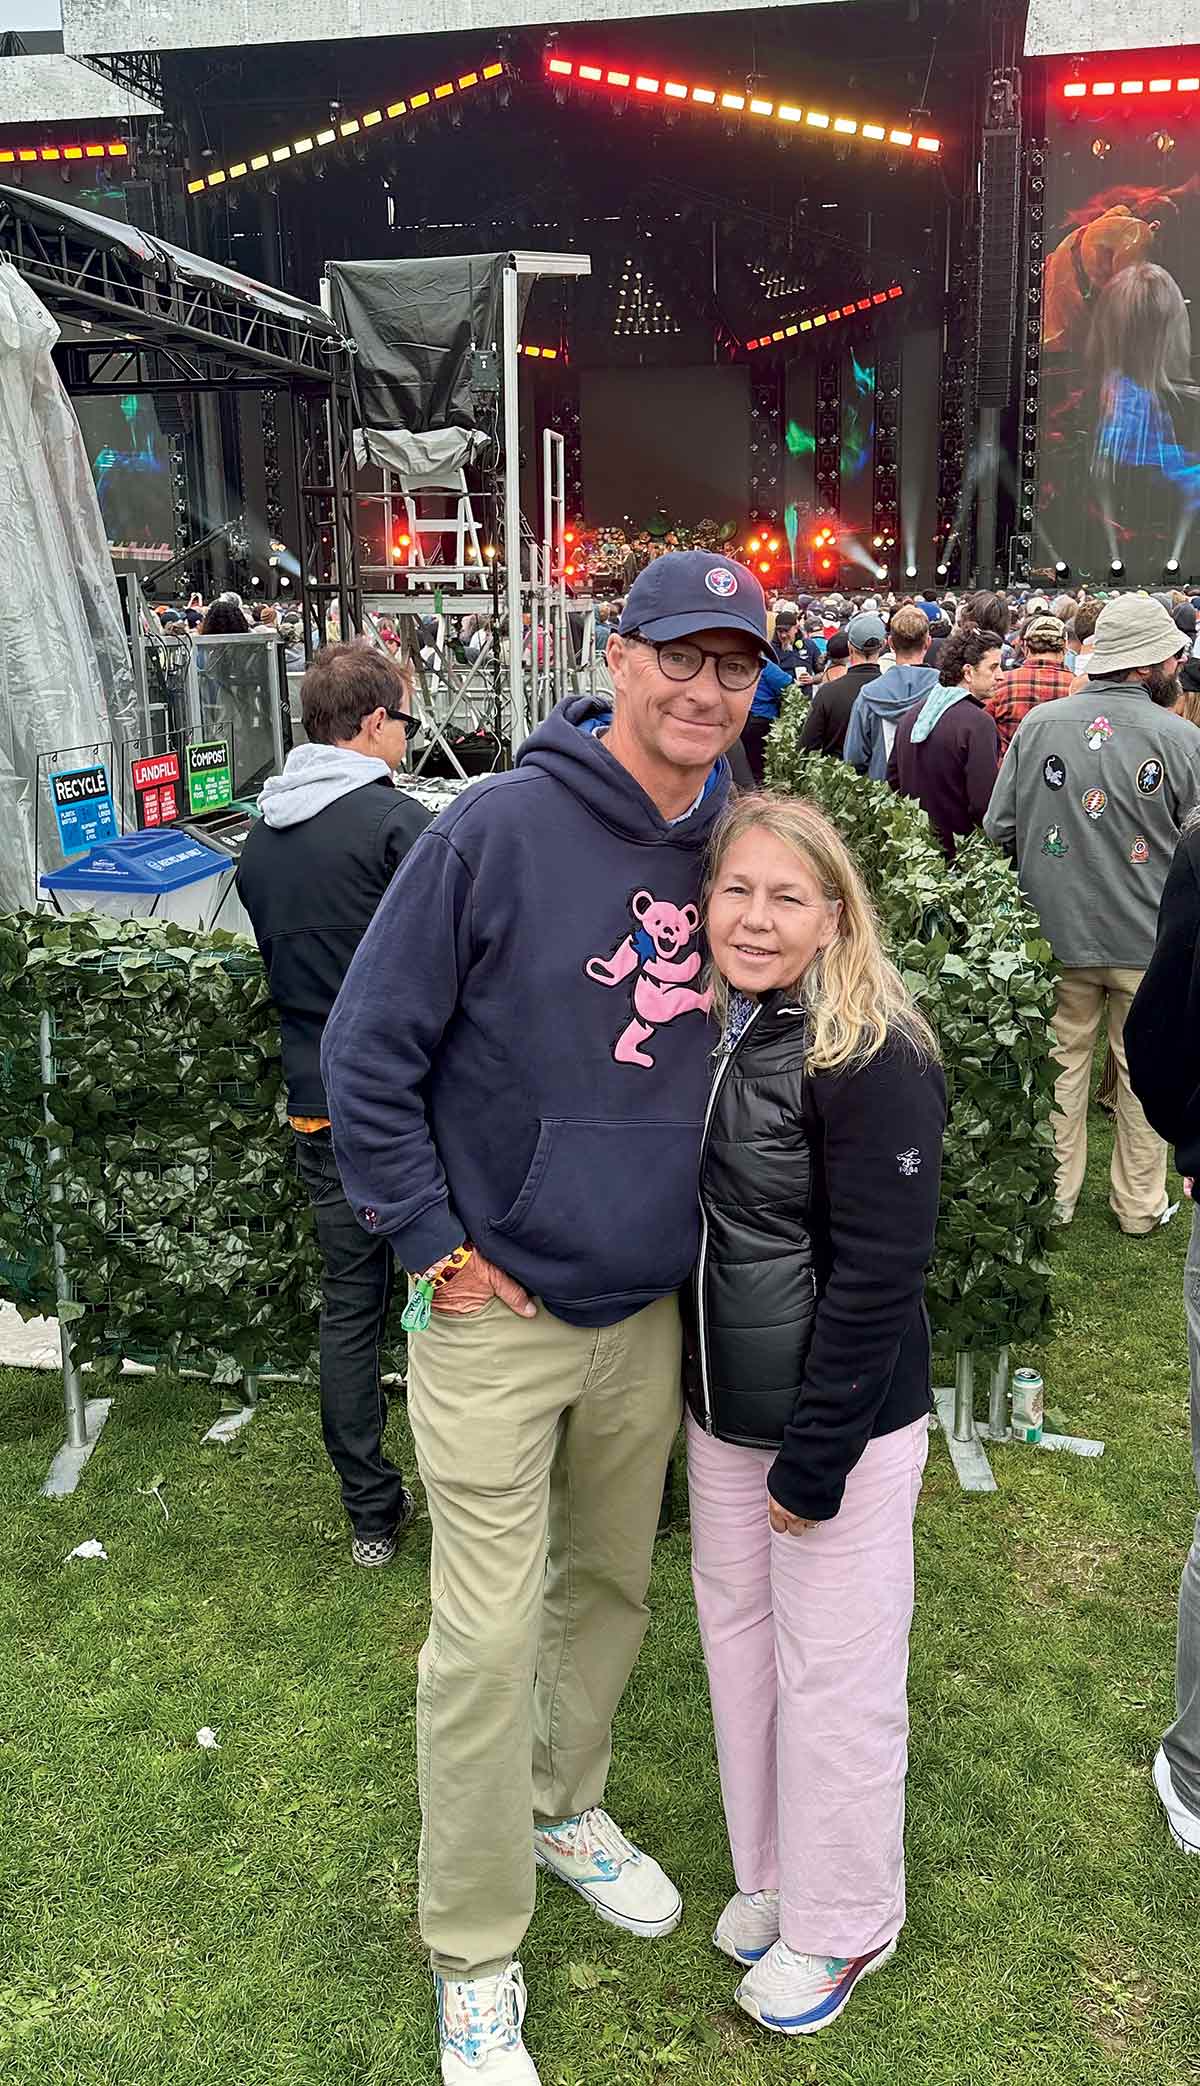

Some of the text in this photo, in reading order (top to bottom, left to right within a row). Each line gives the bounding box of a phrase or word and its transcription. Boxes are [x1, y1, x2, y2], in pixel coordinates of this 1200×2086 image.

[191, 749, 226, 767] COMPOST
[135, 761, 177, 784] LANDFILL
[55, 774, 106, 800] RECYCLE
